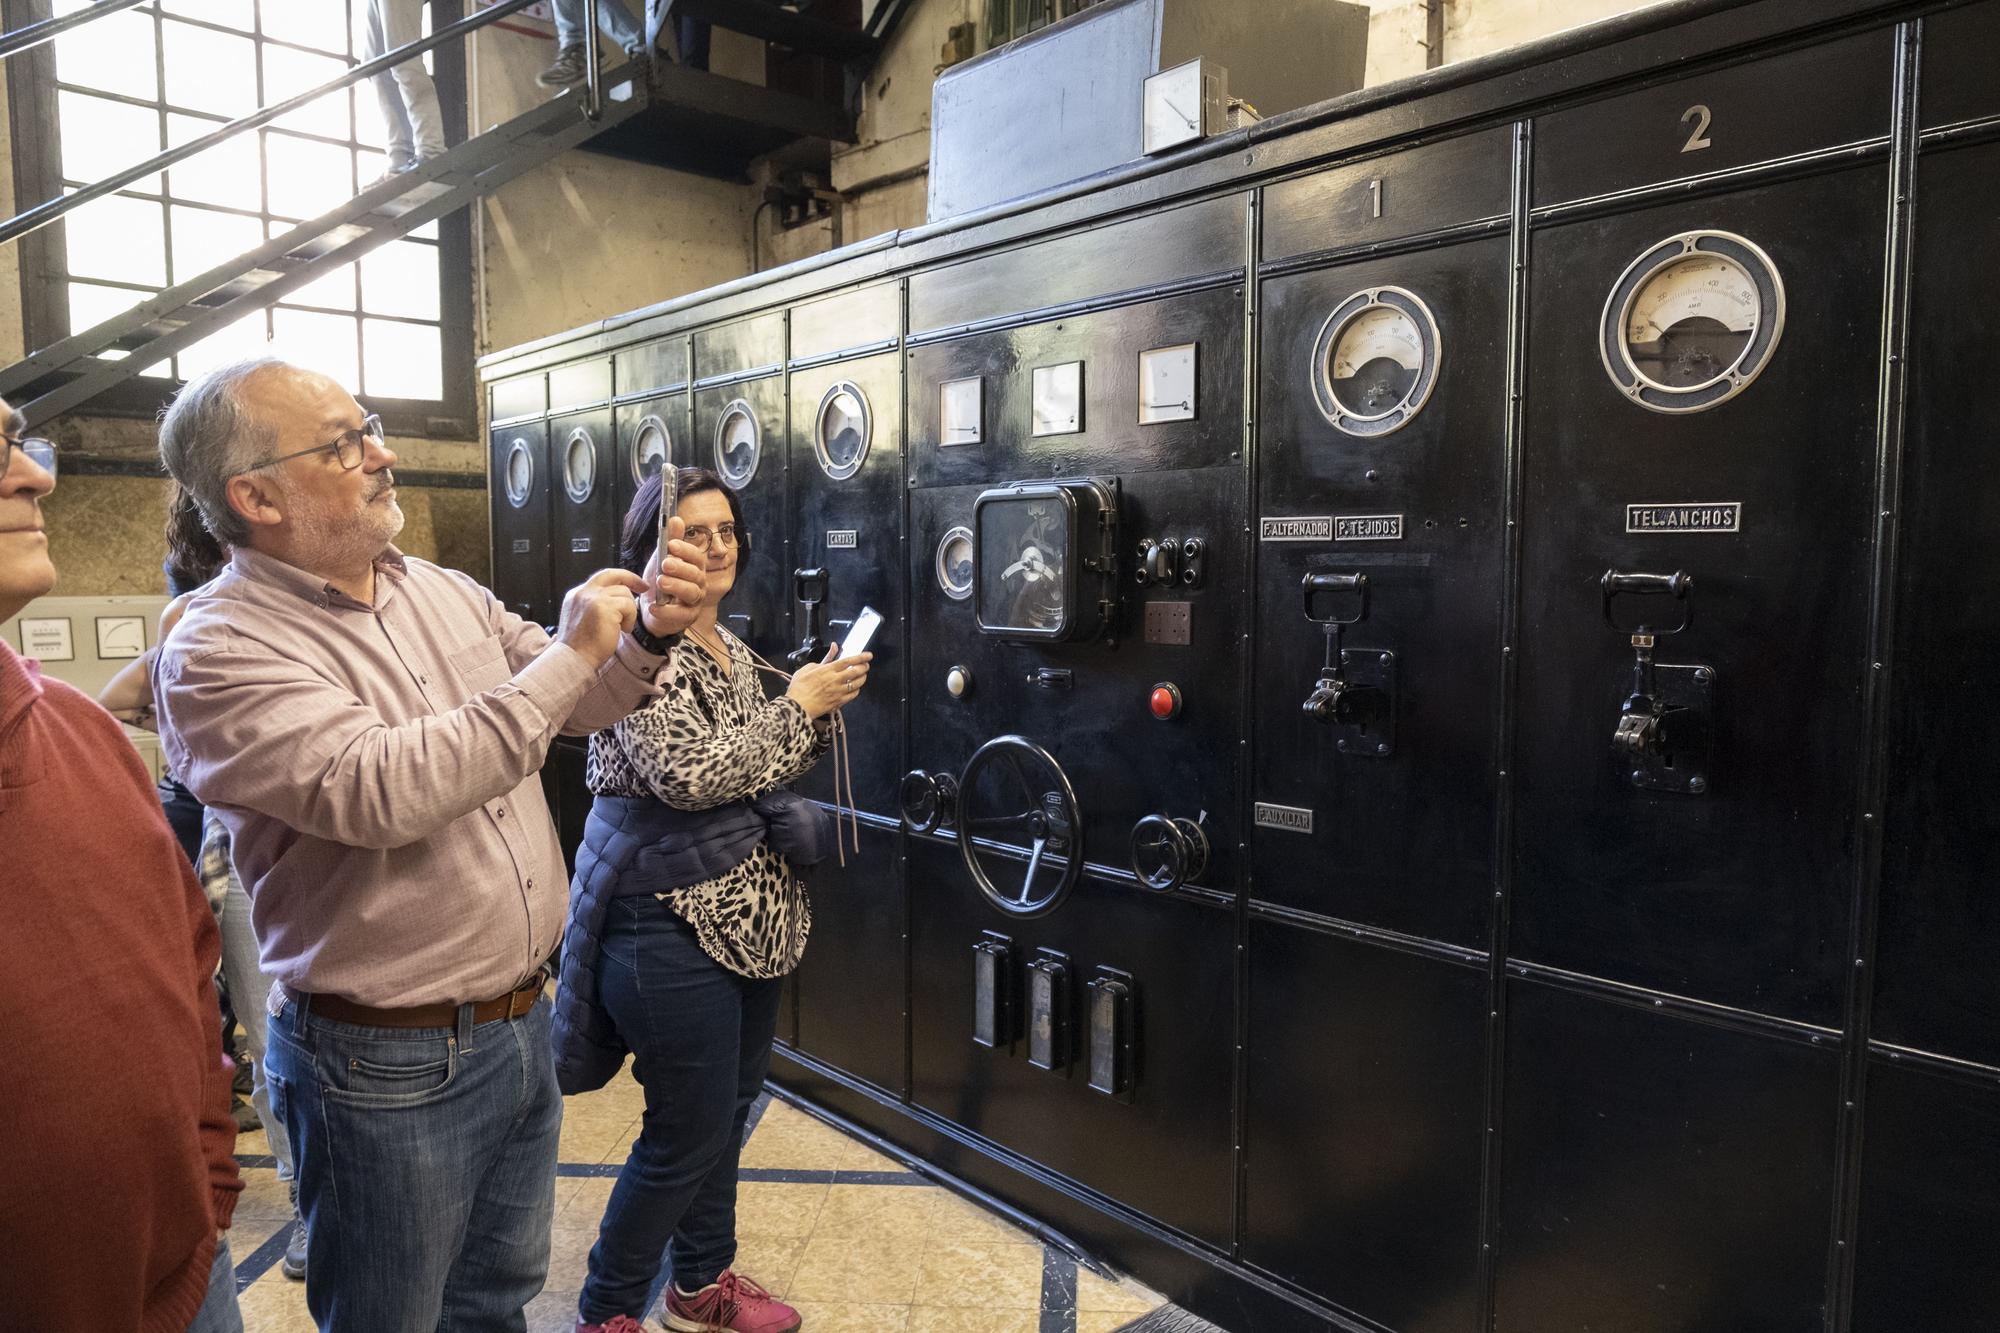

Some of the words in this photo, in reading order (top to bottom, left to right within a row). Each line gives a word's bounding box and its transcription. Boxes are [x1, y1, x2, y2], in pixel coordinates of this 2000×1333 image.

[1680, 104, 1712, 153] 2
[1369, 180, 1382, 218] 1
[1632, 509, 1733, 527] TEL.ANCHOS
[1263, 521, 1329, 537] F.ALTERNADOR
[1338, 520, 1398, 536] P.TEJIDOS
